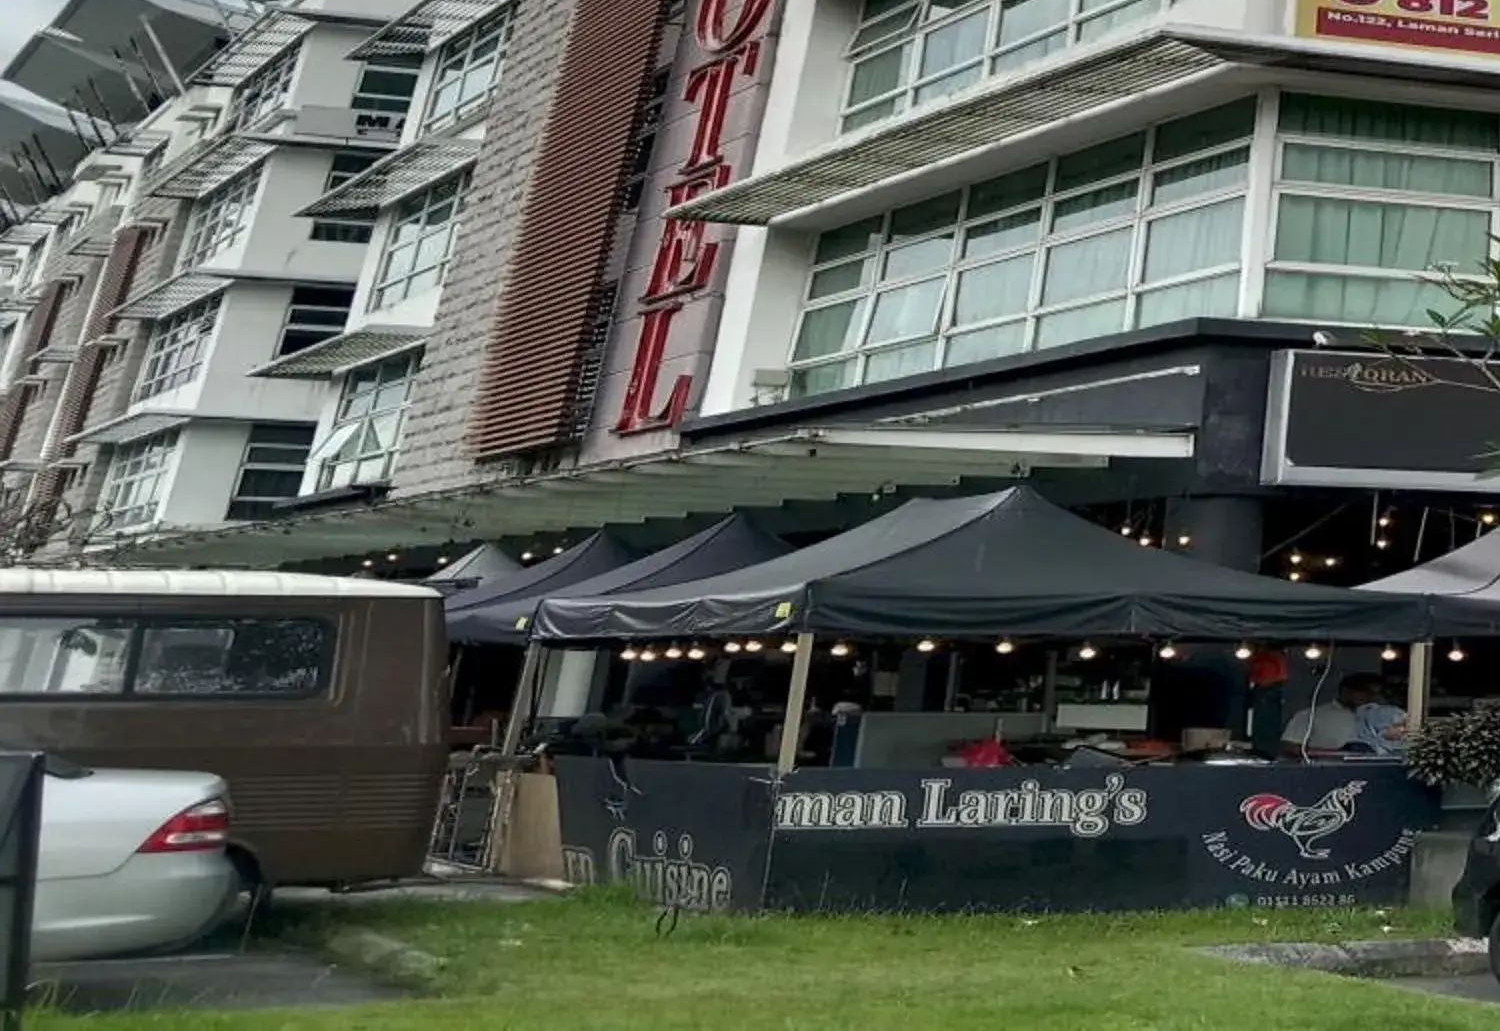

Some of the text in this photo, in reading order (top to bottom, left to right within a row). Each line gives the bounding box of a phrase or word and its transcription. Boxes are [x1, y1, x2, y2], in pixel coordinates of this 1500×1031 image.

[1397, 18, 1459, 36] Laman
[917, 773, 1147, 837] Laring's
[608, 827, 732, 911] Cuisine
[1202, 831, 1234, 863] Nasi
[1229, 856, 1278, 883] Paku
[1283, 869, 1341, 889] Ayam
